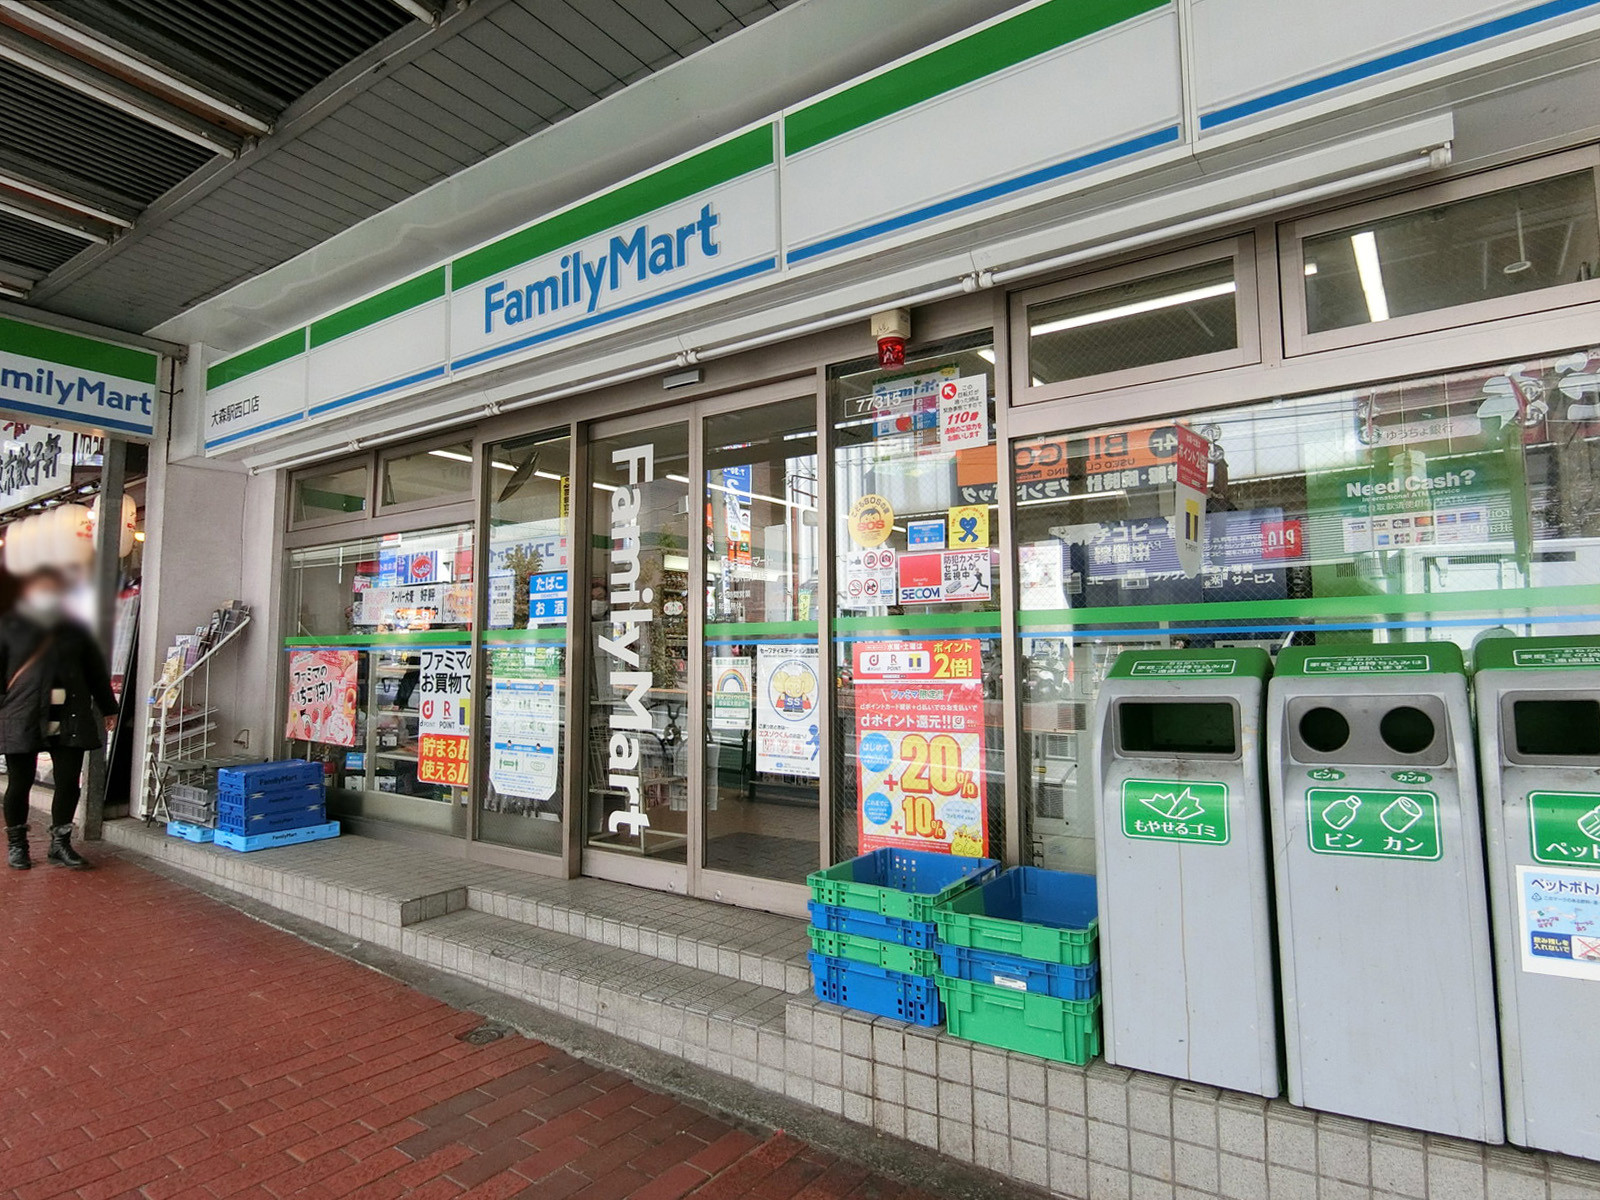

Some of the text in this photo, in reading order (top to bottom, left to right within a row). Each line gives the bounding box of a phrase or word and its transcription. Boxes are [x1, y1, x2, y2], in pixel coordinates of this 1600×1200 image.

[485, 203, 719, 334] FamilyMart
[1, 367, 152, 416] milyMart
[856, 392, 902, 413] 77315
[210, 395, 260, 427] 大森駅西口店
[947, 411, 979, 425] 110番
[0, 433, 62, 496] 京餃子軒
[1347, 469, 1476, 498] Need Cash?
[857, 519, 885, 531] SOS
[943, 552, 989, 564] 防犯カメラで
[944, 562, 976, 573] セコムが
[535, 576, 564, 592] たばこ
[944, 571, 970, 581] 監視中
[1231, 573, 1276, 585] サービス
[901, 587, 940, 600] SECOM
[535, 600, 564, 616] お酒
[598, 443, 654, 837] FamilyMart
[933, 642, 973, 653] ポイント
[933, 653, 973, 678] 2倍!
[294, 665, 328, 685] ファミマの
[421, 672, 471, 695] お買物で
[292, 680, 333, 706] いちご狩り
[787, 697, 800, 706] SS
[439, 721, 455, 729] POINT
[863, 743, 889, 753] はじめて
[260, 774, 298, 786] FamilyMart
[1313, 770, 1339, 780] ビン用
[1397, 772, 1427, 783] カン用
[272, 832, 298, 840] FamilyMart
[1134, 819, 1216, 838] もやせるゴミ
[1324, 833, 1362, 849] ビン
[1383, 836, 1424, 852] カン
[1546, 842, 1600, 859] ペット
[1533, 944, 1570, 953] 入れないで
